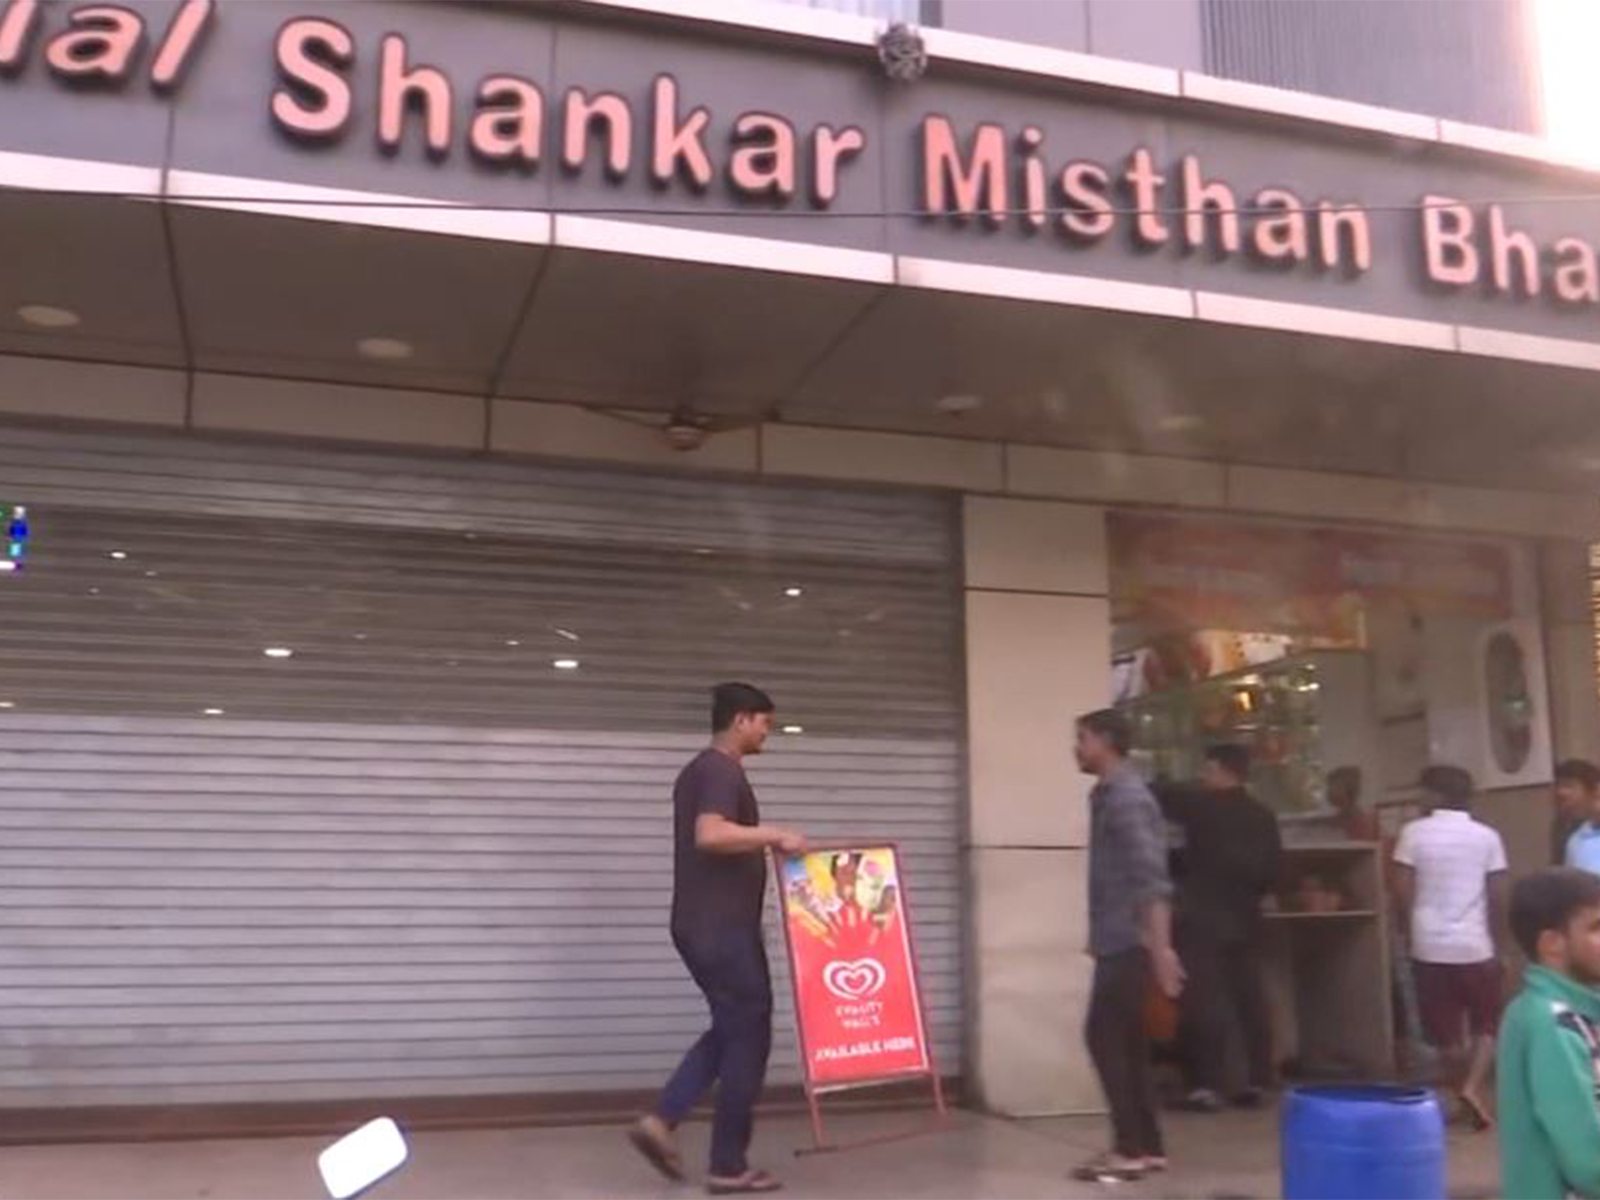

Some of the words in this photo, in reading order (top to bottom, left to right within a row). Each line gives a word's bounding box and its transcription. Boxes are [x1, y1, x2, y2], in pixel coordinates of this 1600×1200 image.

[271, 16, 864, 206] Shankar
[921, 115, 1371, 271] Misthan
[1422, 194, 1600, 303] Bha
